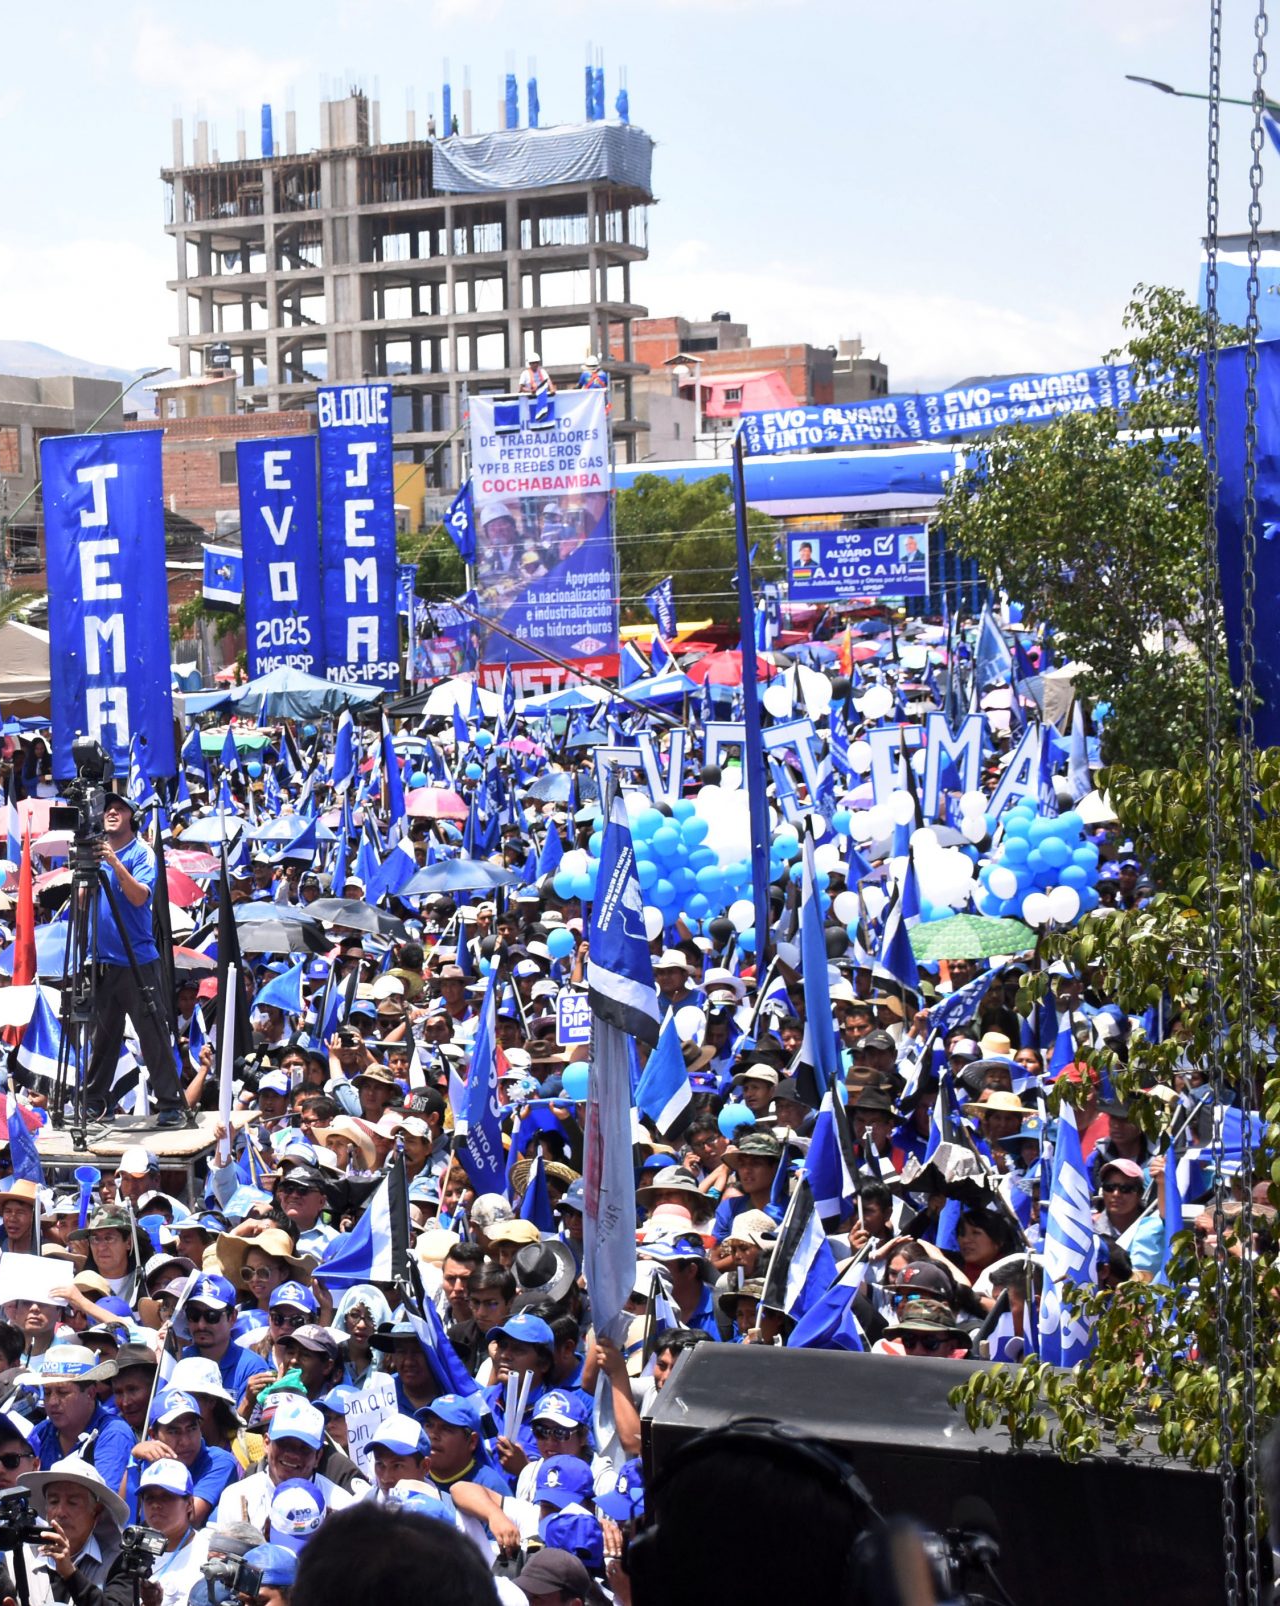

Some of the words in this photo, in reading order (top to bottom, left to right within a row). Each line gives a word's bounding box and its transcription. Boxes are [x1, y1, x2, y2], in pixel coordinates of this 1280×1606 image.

[318, 386, 389, 428] BLOQUE
[944, 406, 1008, 430] VINTO
[1026, 393, 1097, 418] APOYA
[480, 436, 496, 447] DE
[500, 428, 599, 447] TRABAJADORES
[761, 425, 823, 450] VINTO
[839, 423, 909, 442] APOYA
[500, 445, 582, 460] PETROLEROS
[478, 463, 510, 475] YPFB
[514, 459, 555, 473] REDES
[559, 459, 575, 470] DE
[579, 456, 604, 469] GAS
[482, 473, 601, 493] COCHABAMBA
[260, 450, 298, 602] EVO
[836, 534, 861, 544] EVO
[344, 441, 379, 662] JEMA
[826, 548, 872, 559] ALVARO
[565, 568, 611, 588] Apoyando
[813, 564, 907, 579] AJUCAM
[527, 590, 537, 604] la
[539, 586, 612, 603] nacionalización
[76, 463, 129, 747] JEMA
[526, 611, 533, 621] e
[534, 603, 612, 621] industrialización
[516, 625, 527, 639] de
[530, 624, 545, 638] los
[547, 621, 613, 637] hidrocarburos
[327, 661, 400, 684] MAS-IPSP
[562, 996, 591, 1013] SA
[562, 1012, 591, 1027] DIP
[295, 1508, 312, 1516] EVO
